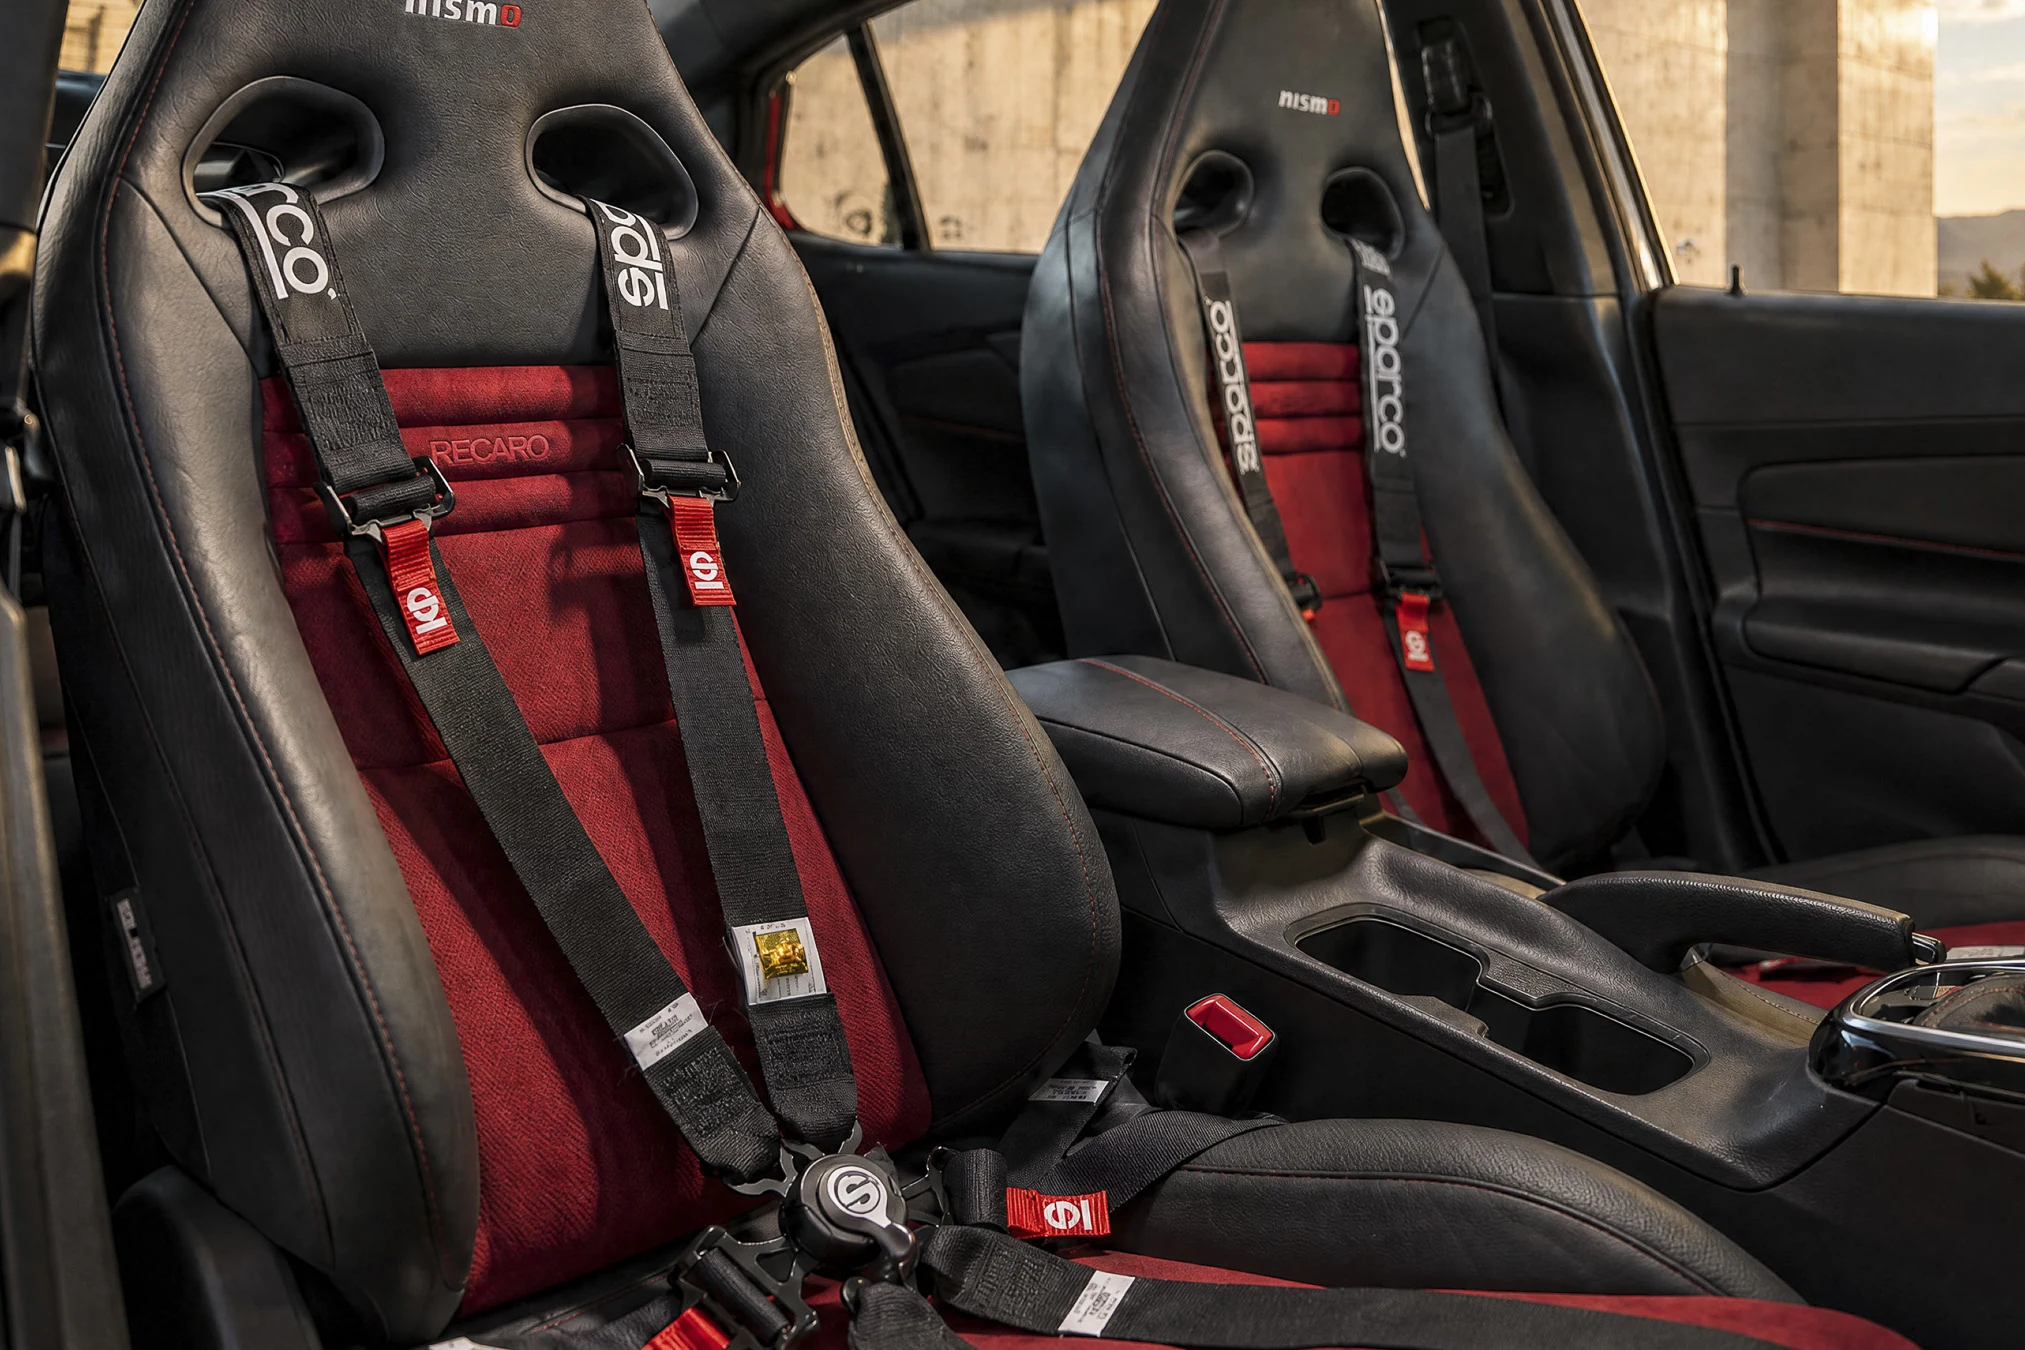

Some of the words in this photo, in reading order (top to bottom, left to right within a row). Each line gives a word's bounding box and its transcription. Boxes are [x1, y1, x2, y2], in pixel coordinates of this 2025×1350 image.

[1278, 90, 1341, 116] nismo
[1207, 299, 1259, 475] sparco
[429, 434, 550, 466] RECARO
